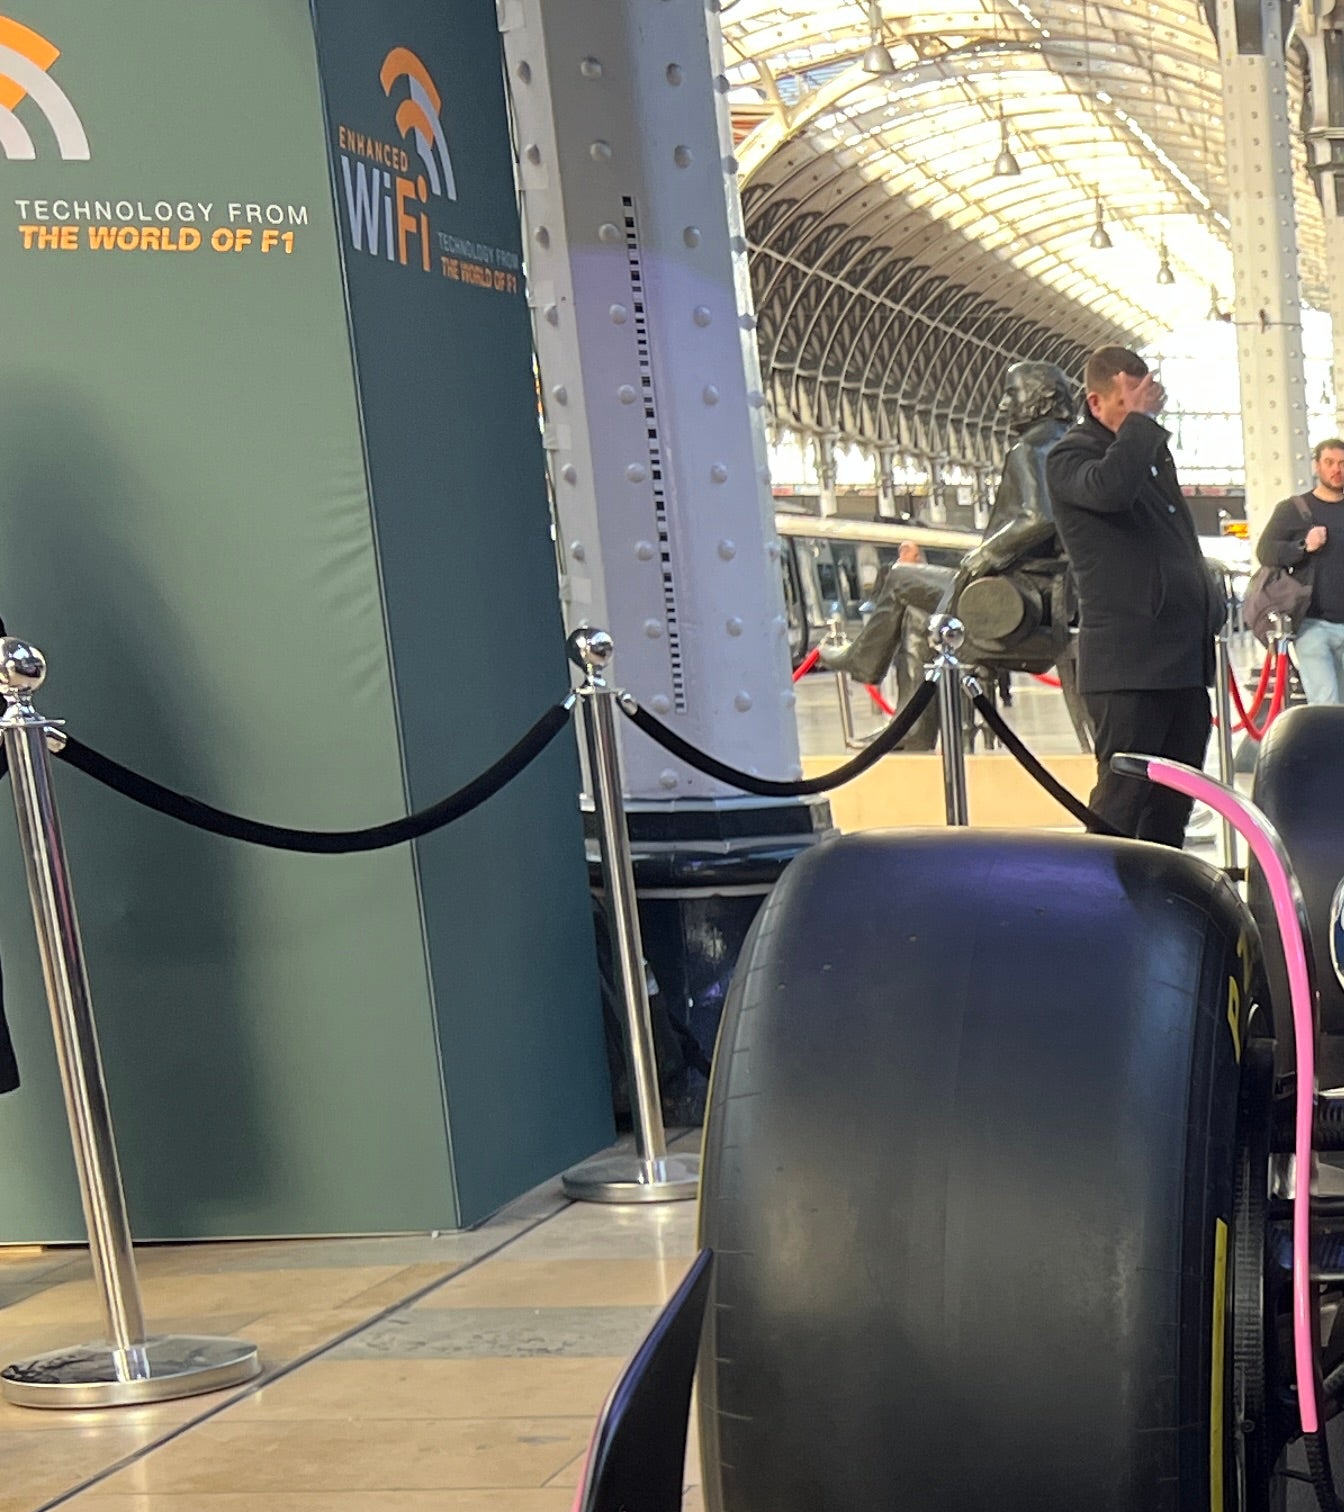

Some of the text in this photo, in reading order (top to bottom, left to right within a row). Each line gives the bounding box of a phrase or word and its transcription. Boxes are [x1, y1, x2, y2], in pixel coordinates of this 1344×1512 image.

[339, 126, 409, 172] ENHANCED
[15, 199, 309, 225] TECHNOLOGY FROM
[340, 154, 431, 272] WiFi
[18, 225, 295, 254] THE WORLD OF F1
[441, 255, 460, 281] THE
[460, 260, 493, 288] WORLD
